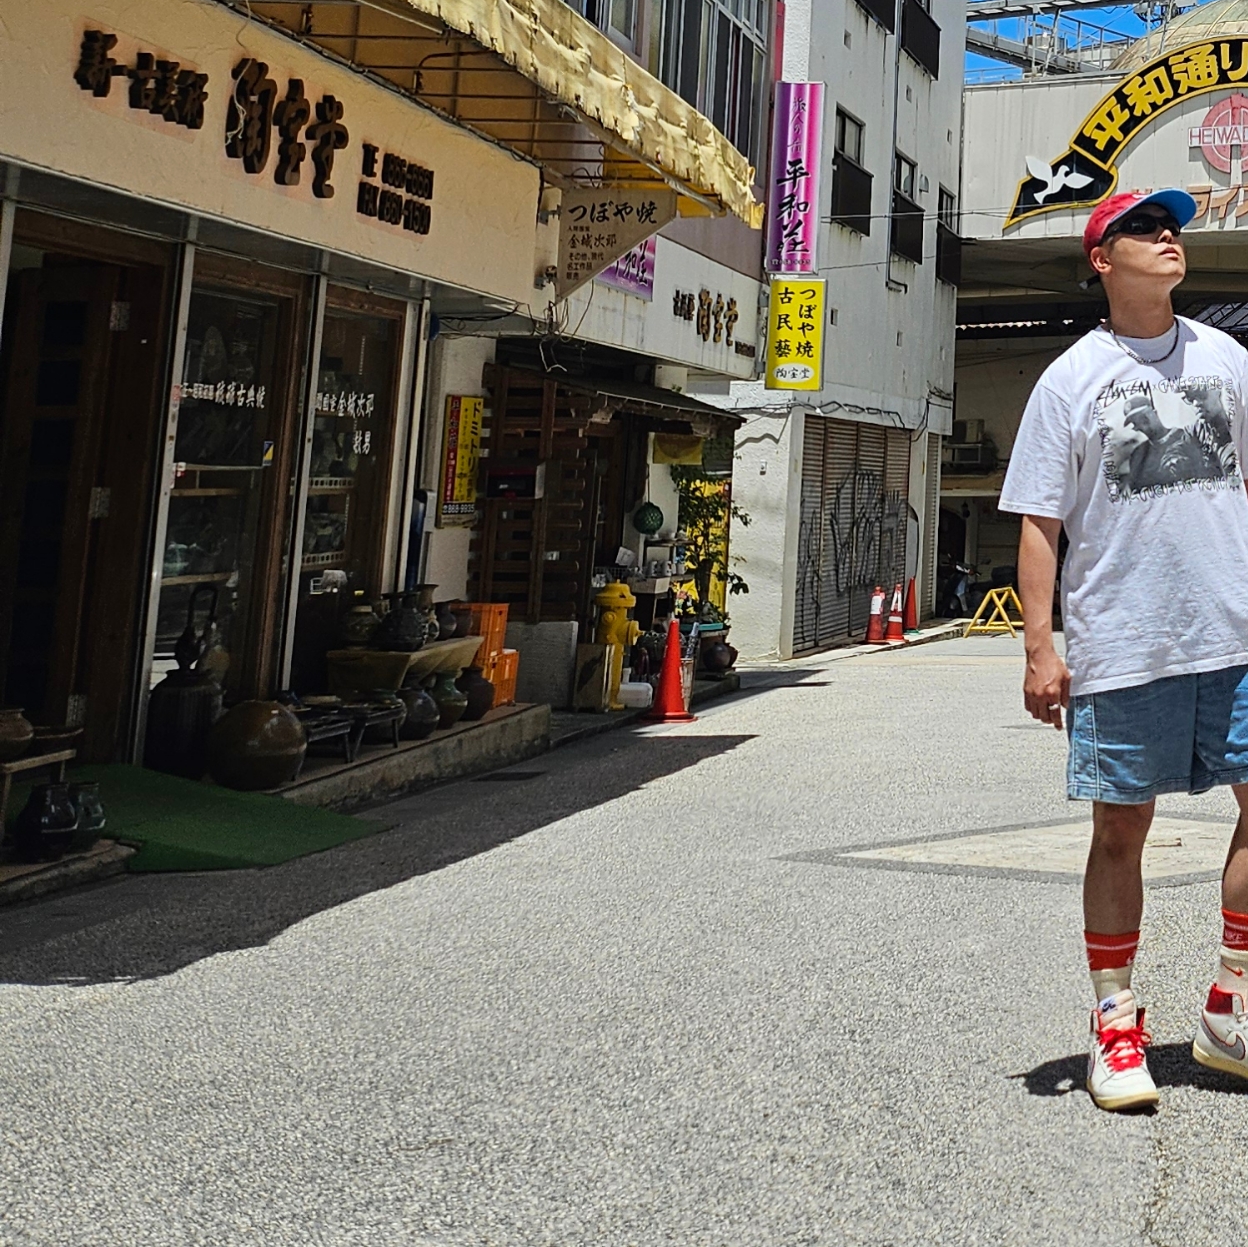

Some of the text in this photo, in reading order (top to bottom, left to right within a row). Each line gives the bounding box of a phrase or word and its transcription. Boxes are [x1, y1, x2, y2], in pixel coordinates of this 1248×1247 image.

[568, 200, 657, 224] つぼや焼
[795, 288, 817, 359] つぼや焼
